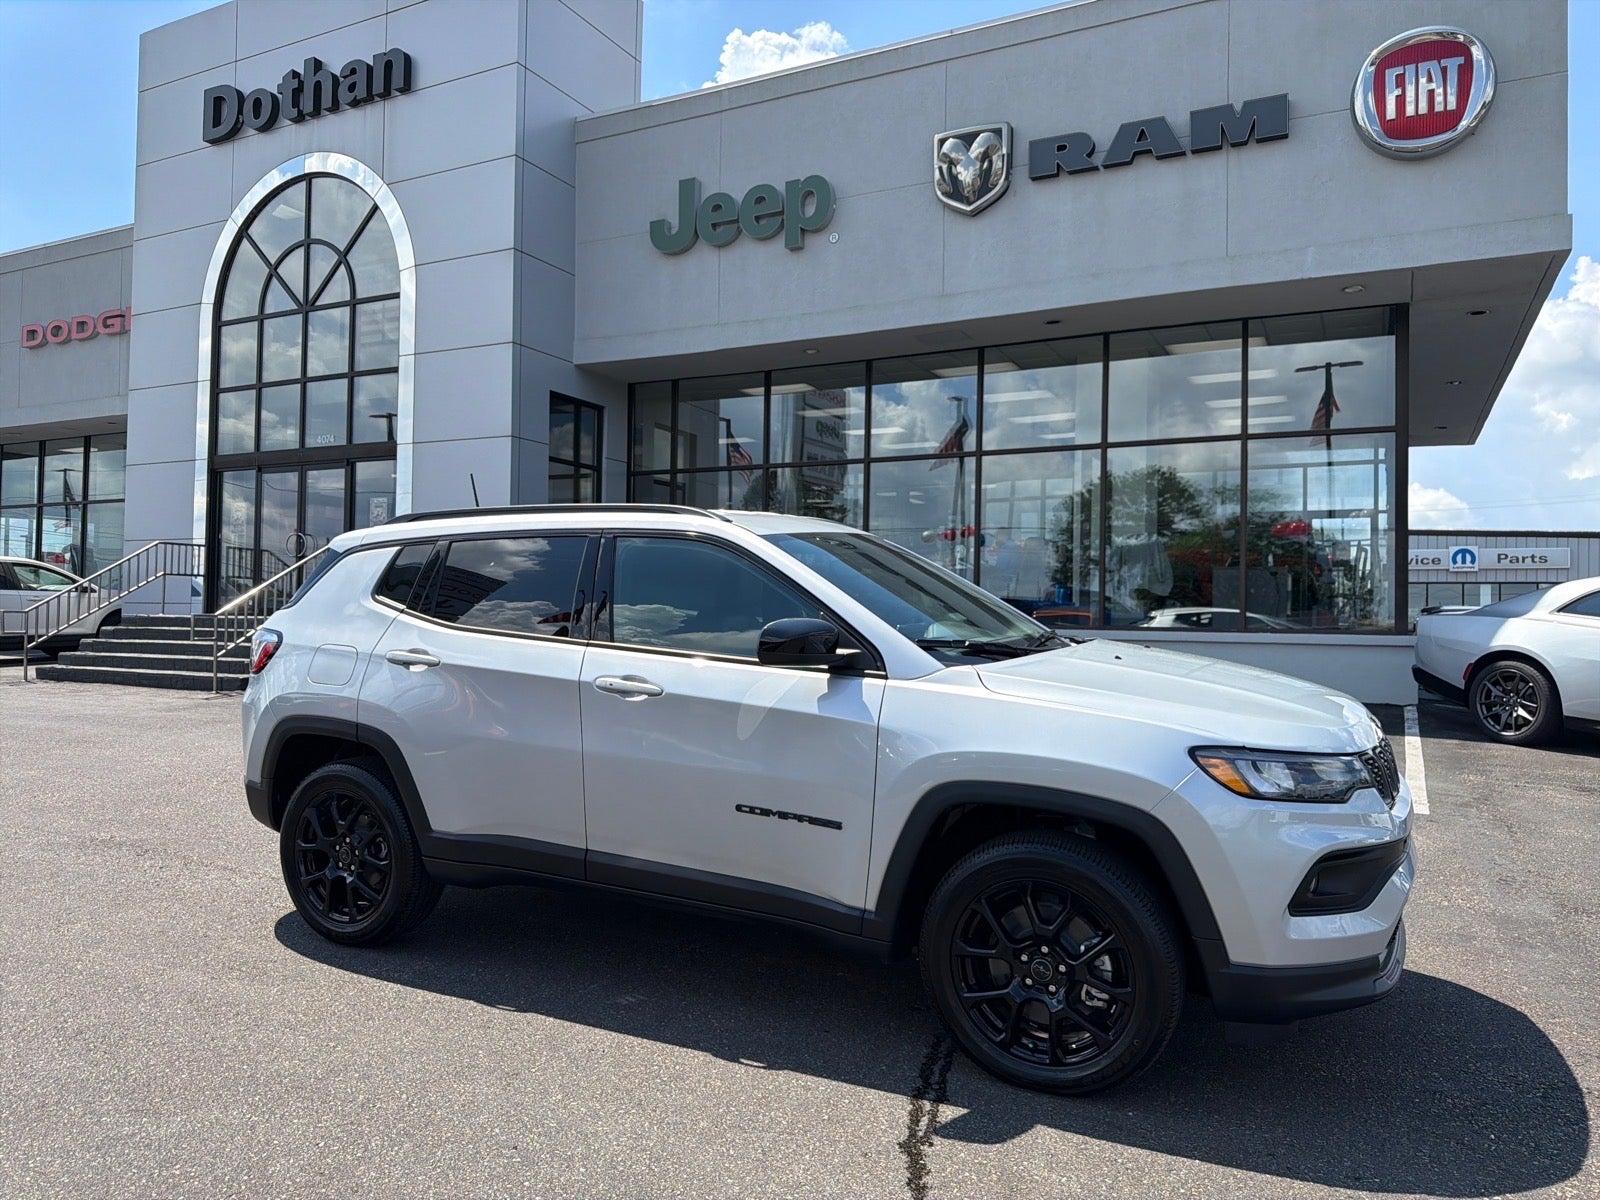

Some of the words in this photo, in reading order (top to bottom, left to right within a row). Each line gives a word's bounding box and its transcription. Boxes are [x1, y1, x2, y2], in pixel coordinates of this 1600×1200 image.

[203, 47, 412, 144] Dothan
[1385, 56, 1465, 121] FIAT
[1028, 92, 1289, 181] RAM
[649, 174, 837, 255] Jeep
[317, 434, 335, 443] 4074
[1408, 554, 1441, 566] vice
[1497, 552, 1548, 564] Parts
[735, 804, 843, 831] COMPASS
